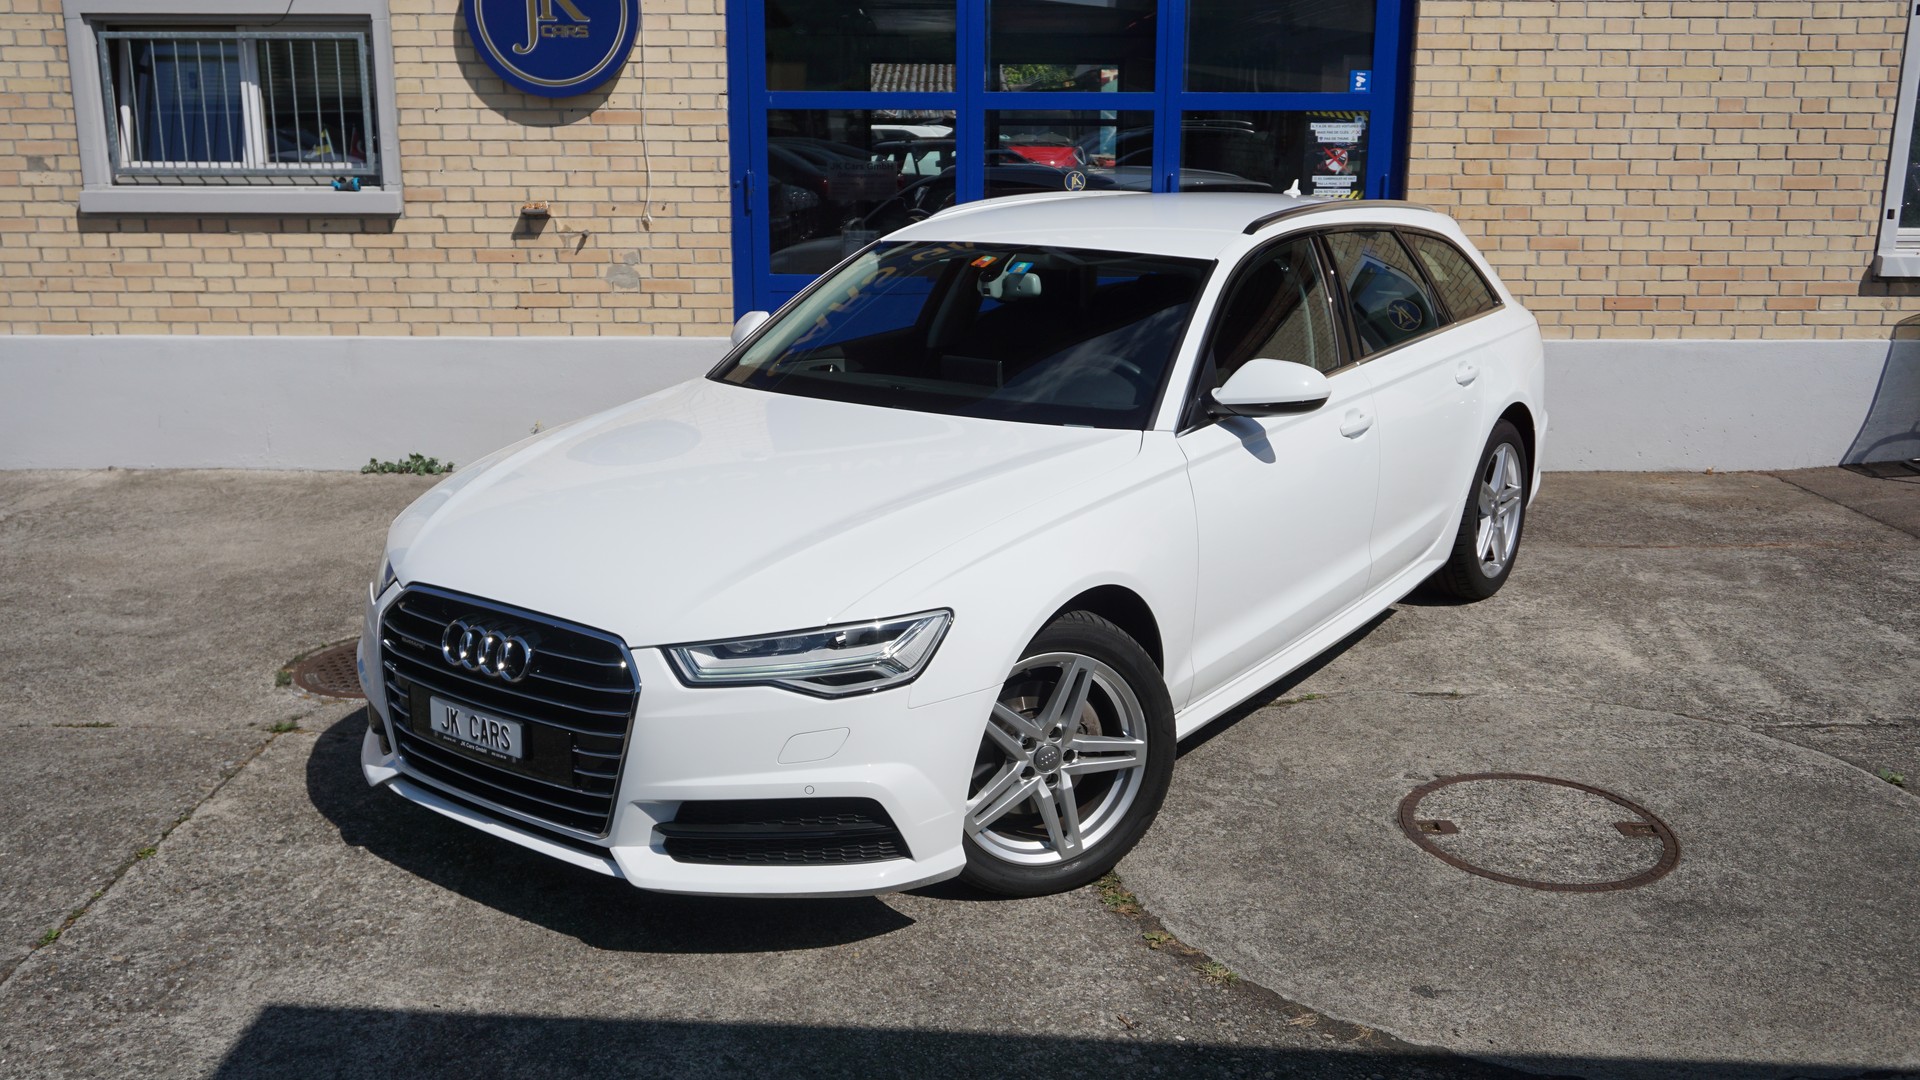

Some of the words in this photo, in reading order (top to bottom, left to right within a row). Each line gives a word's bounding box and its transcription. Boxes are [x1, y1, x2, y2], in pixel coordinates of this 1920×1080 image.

[541, 25, 589, 38] CARS
[441, 705, 460, 736] JK
[469, 715, 511, 752] CARS
